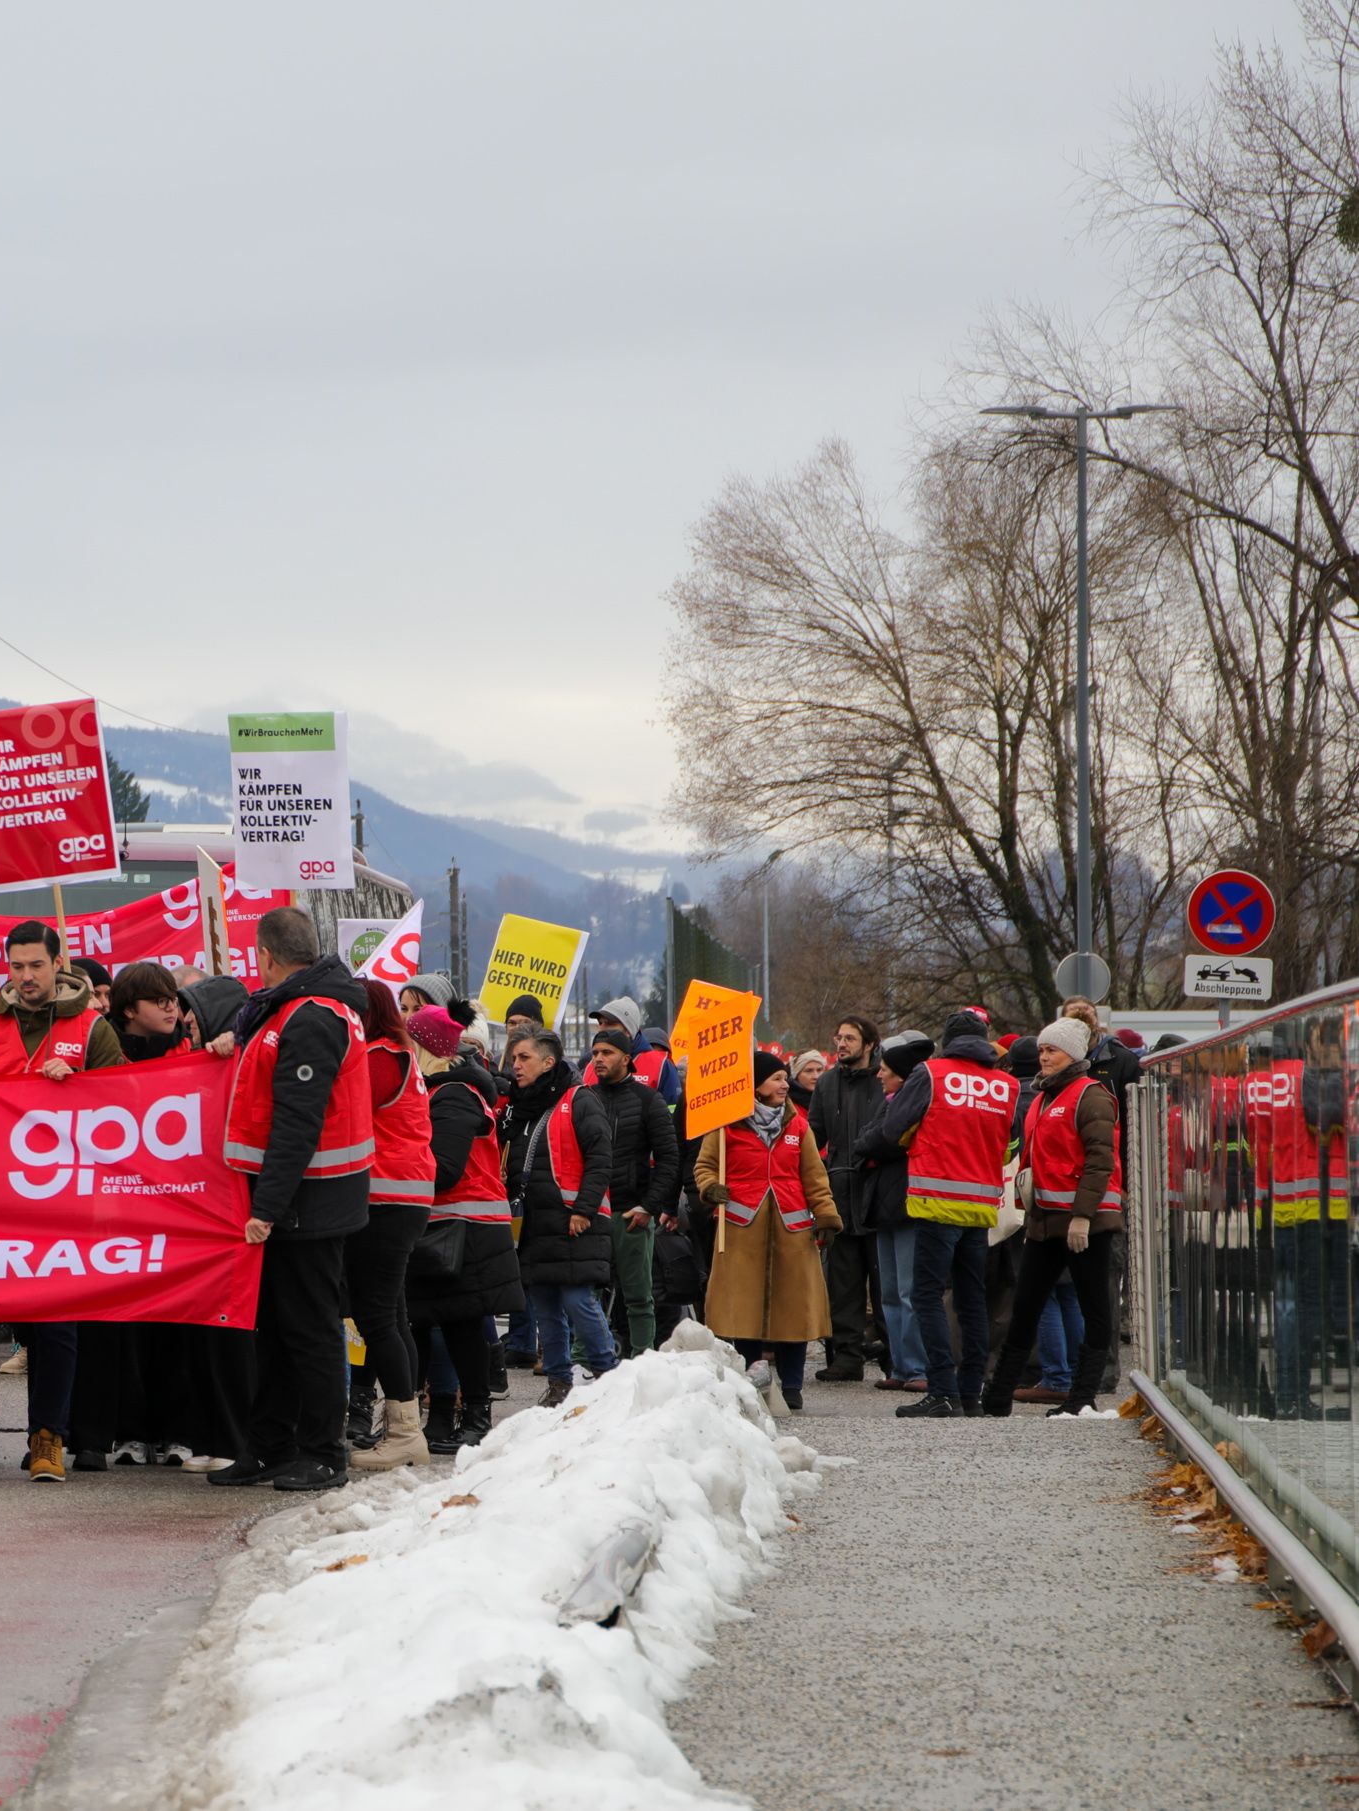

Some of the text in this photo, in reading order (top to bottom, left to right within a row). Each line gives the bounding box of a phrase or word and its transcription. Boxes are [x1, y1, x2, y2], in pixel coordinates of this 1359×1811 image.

[238, 728, 324, 737] #WirBrauchenMehr
[24, 766, 98, 787] UNSEREN
[238, 768, 262, 780] WIR
[239, 781, 302, 796] KÄMPFEN
[240, 797, 332, 811] FÜR UNSEREN
[241, 815, 318, 827] KOLLEKTIV-
[241, 830, 305, 842] VERTRAG!
[58, 834, 106, 863] gpa
[299, 861, 335, 880] gpa
[494, 949, 567, 978] HIER WIRD
[488, 970, 562, 1000] GESTREIKT!
[1195, 982, 1262, 996] Abschleppzone
[697, 1015, 743, 1049] HIER
[54, 1042, 82, 1056] gpa
[699, 1051, 738, 1078] WIRD
[690, 1072, 750, 1110] GESTREIKT!
[944, 1072, 1010, 1108] gpa
[7, 1093, 203, 1199] gpa
[101, 1181, 206, 1195] GEWERKSCHAFT
[102, 1174, 144, 1185] MEINE
